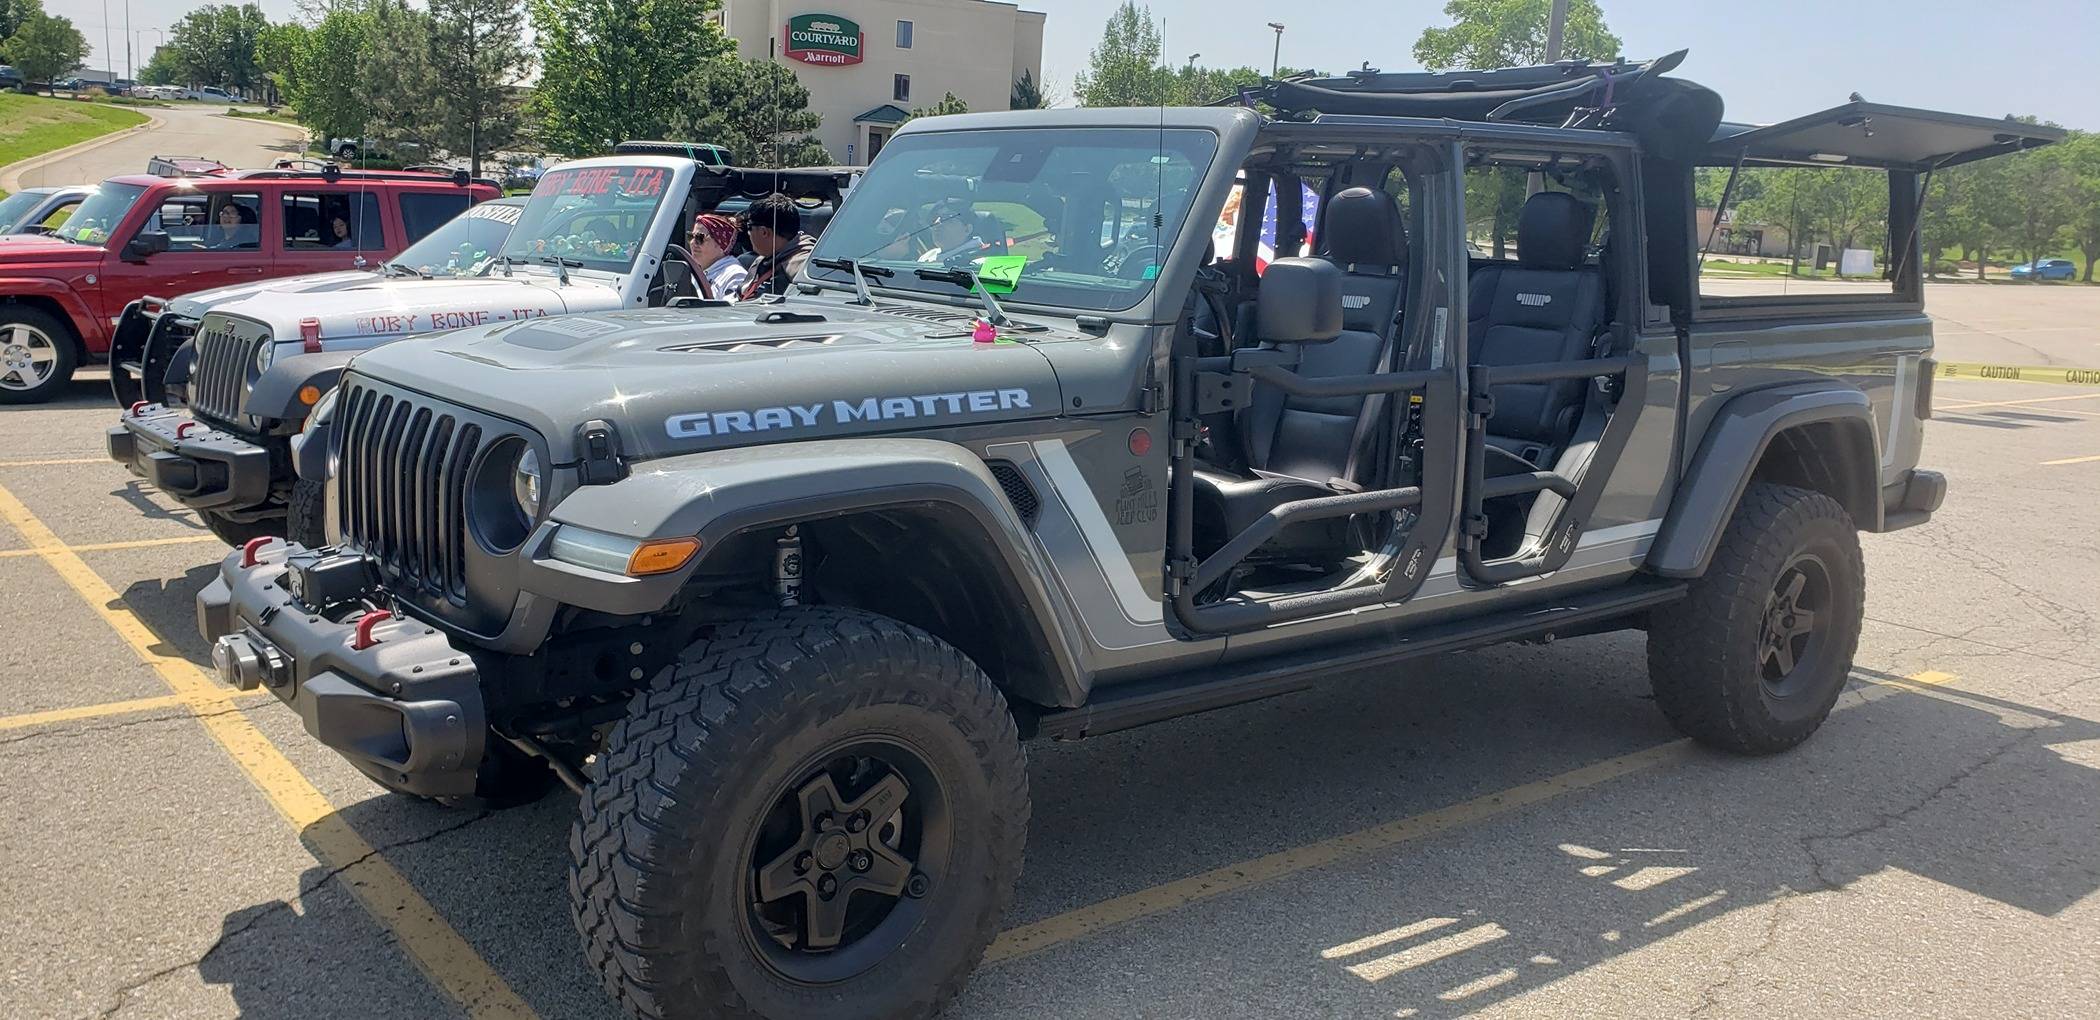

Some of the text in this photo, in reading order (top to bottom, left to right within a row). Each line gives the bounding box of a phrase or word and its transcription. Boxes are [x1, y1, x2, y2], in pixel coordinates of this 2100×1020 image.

[791, 31, 858, 47] COURTYARD
[804, 51, 845, 64] Marriott
[625, 167, 665, 196] ITA
[1980, 366, 2021, 380] CAUTION
[663, 387, 1033, 440] GRAY MATTER
